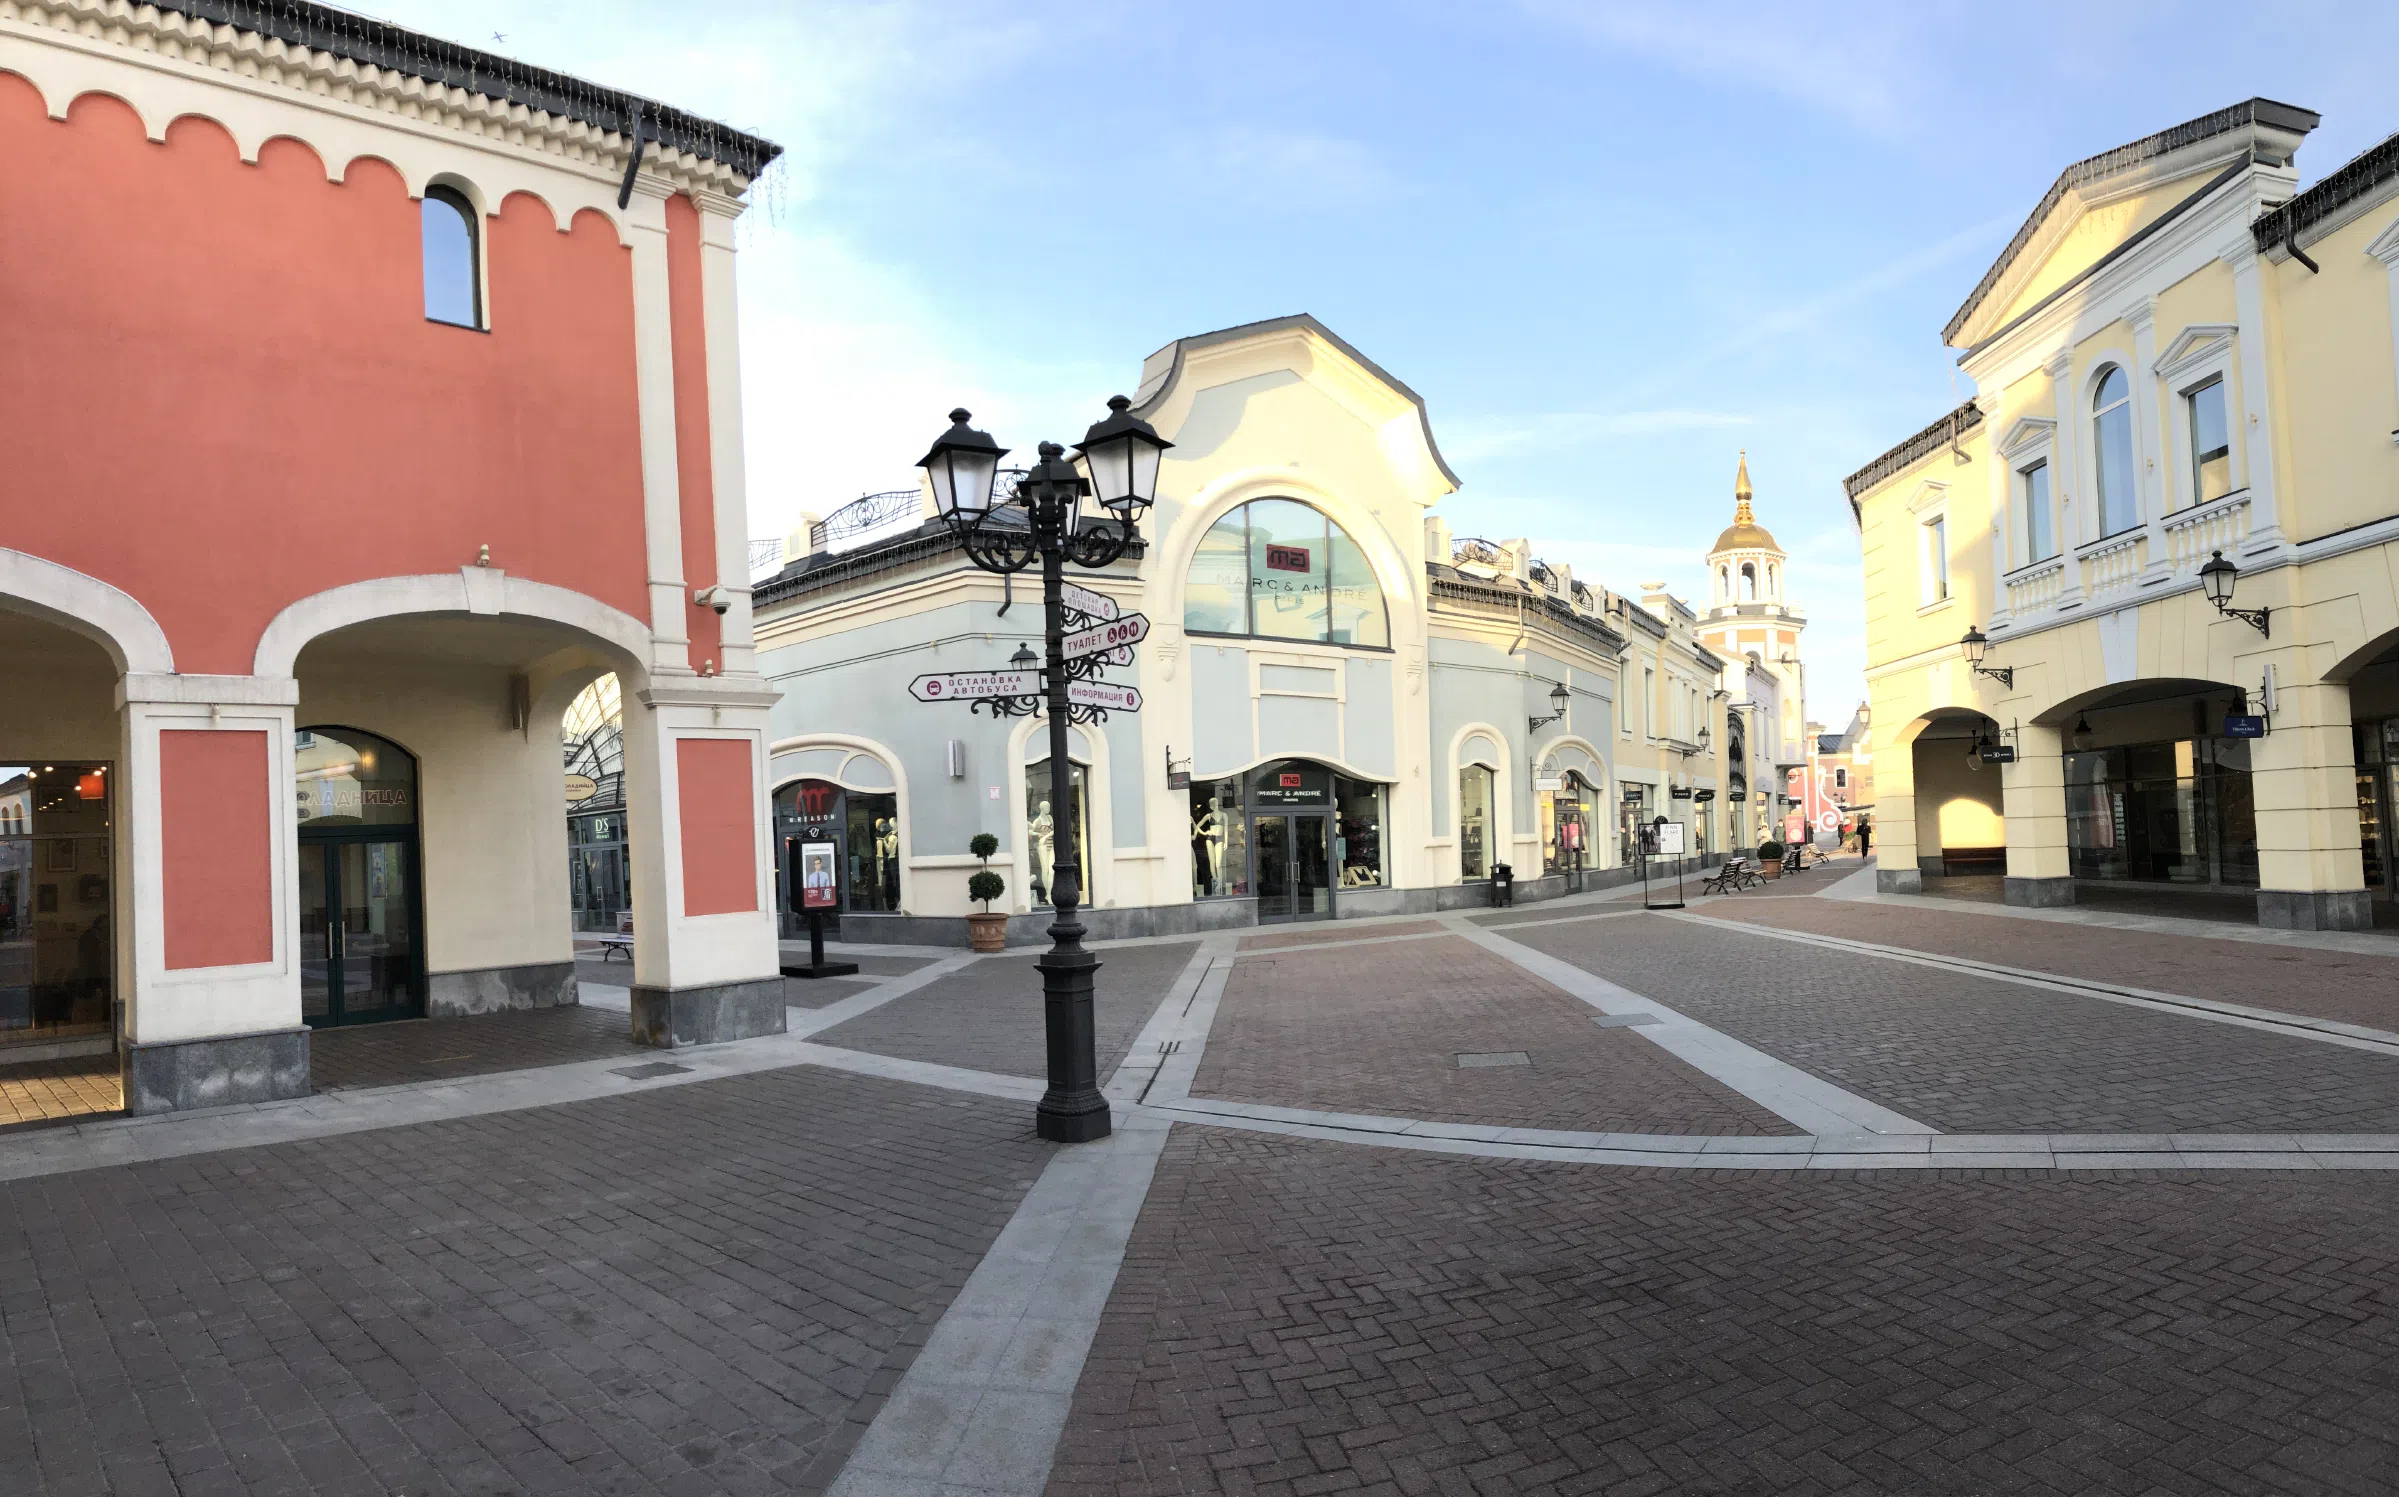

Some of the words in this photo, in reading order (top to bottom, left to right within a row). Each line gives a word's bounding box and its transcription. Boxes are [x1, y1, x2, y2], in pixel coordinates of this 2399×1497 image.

[1217, 573, 1278, 590] MARC
[1284, 579, 1294, 592] &
[1067, 597, 1102, 614] ПЛОЩАДКА
[1071, 590, 1099, 606] ДЕТСКАЯ
[1067, 633, 1102, 652] ТУАЛЕТ
[948, 675, 1022, 687] ОСТАНОВКА
[953, 684, 1018, 695] АВТОБУСА
[1071, 687, 1123, 702] ИНФОРМАЦИЯ
[1283, 776, 1299, 784] ma
